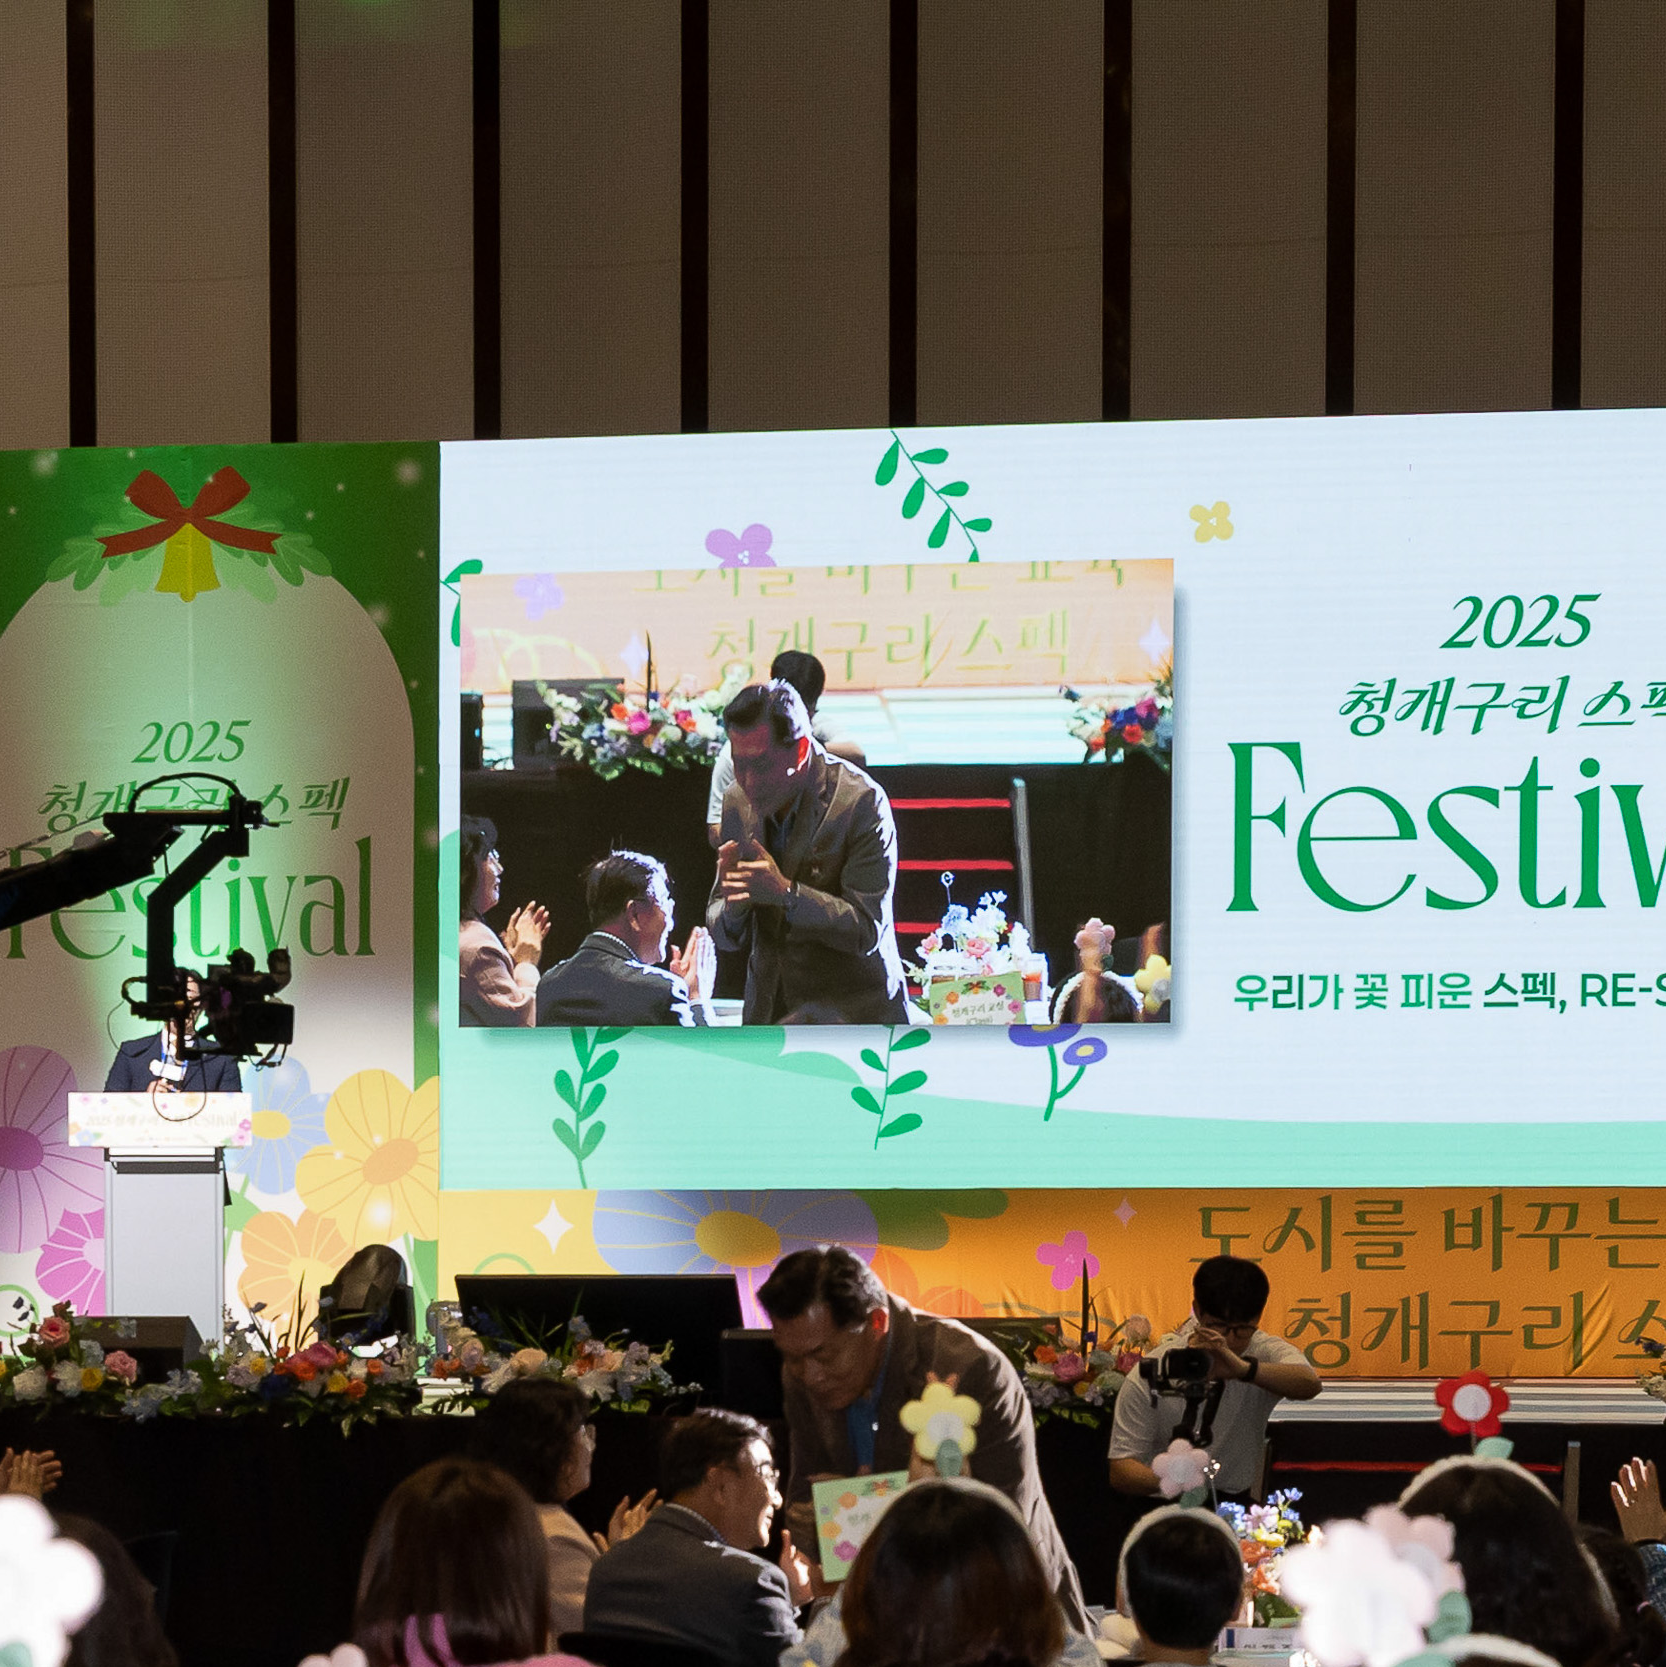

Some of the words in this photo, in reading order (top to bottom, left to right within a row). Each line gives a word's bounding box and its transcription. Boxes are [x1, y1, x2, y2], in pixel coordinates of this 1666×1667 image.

[955, 607, 1070, 676] 스펙
[1440, 593, 1601, 649] 2025
[1338, 675, 1570, 738] 청개구리
[132, 720, 251, 763] 2025
[1233, 973, 1345, 1012] 우리가
[1353, 973, 1389, 1011] 꽃
[1400, 972, 1473, 1010] 피운
[1482, 971, 1569, 1015] 스펙,
[1188, 1193, 1418, 1274] 도시를
[1283, 1290, 1584, 1371] 청개구리
